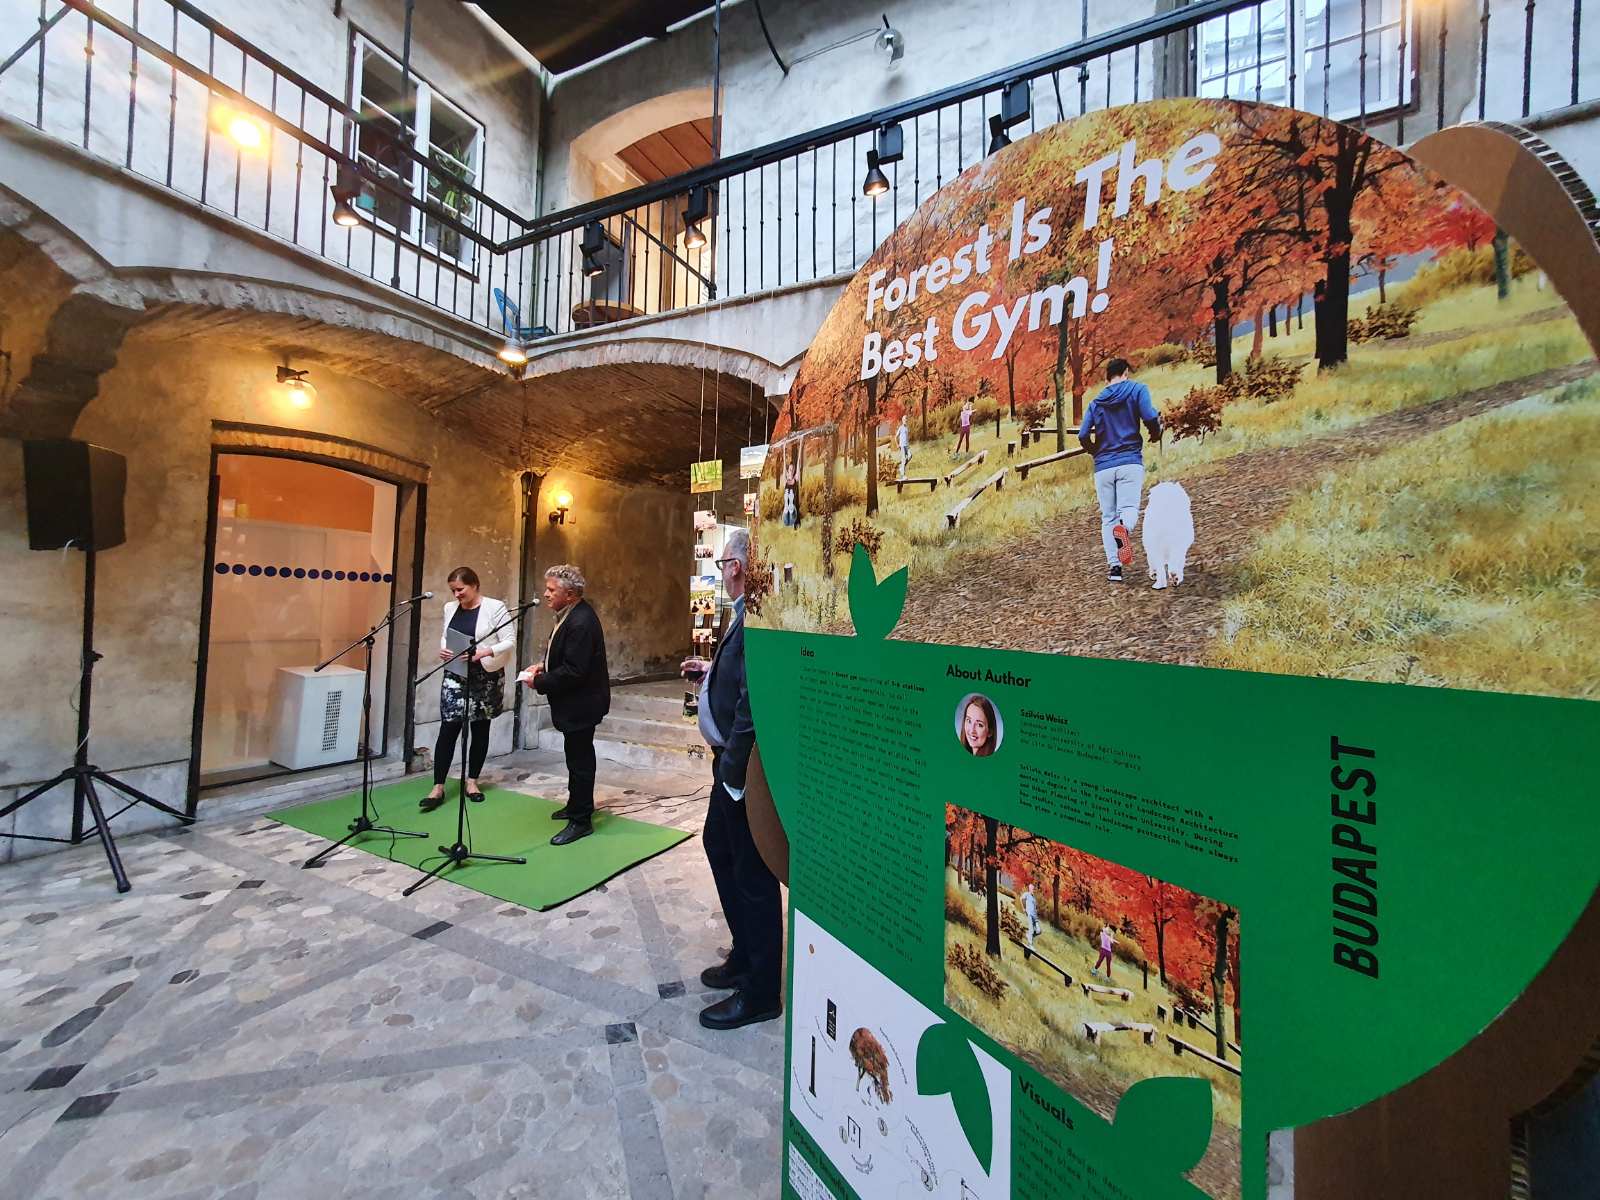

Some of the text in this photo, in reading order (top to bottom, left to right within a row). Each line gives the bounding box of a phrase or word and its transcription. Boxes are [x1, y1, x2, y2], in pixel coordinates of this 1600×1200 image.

[865, 132, 1222, 322] Forest Is The
[860, 237, 1114, 381] Best Gym!
[800, 646, 815, 658] Idea
[946, 663, 1032, 689] About Author
[1020, 708, 1045, 721] Szilvia
[1045, 713, 1069, 726] Weisz
[1141, 797, 1180, 812] architect
[1184, 807, 1204, 819] with
[1179, 817, 1240, 840] Architecture
[1193, 832, 1225, 849] During
[1136, 827, 1182, 847] protection
[1208, 848, 1240, 864] always
[1330, 735, 1379, 979] BUDAPEST
[1018, 1075, 1075, 1130] Visuals
